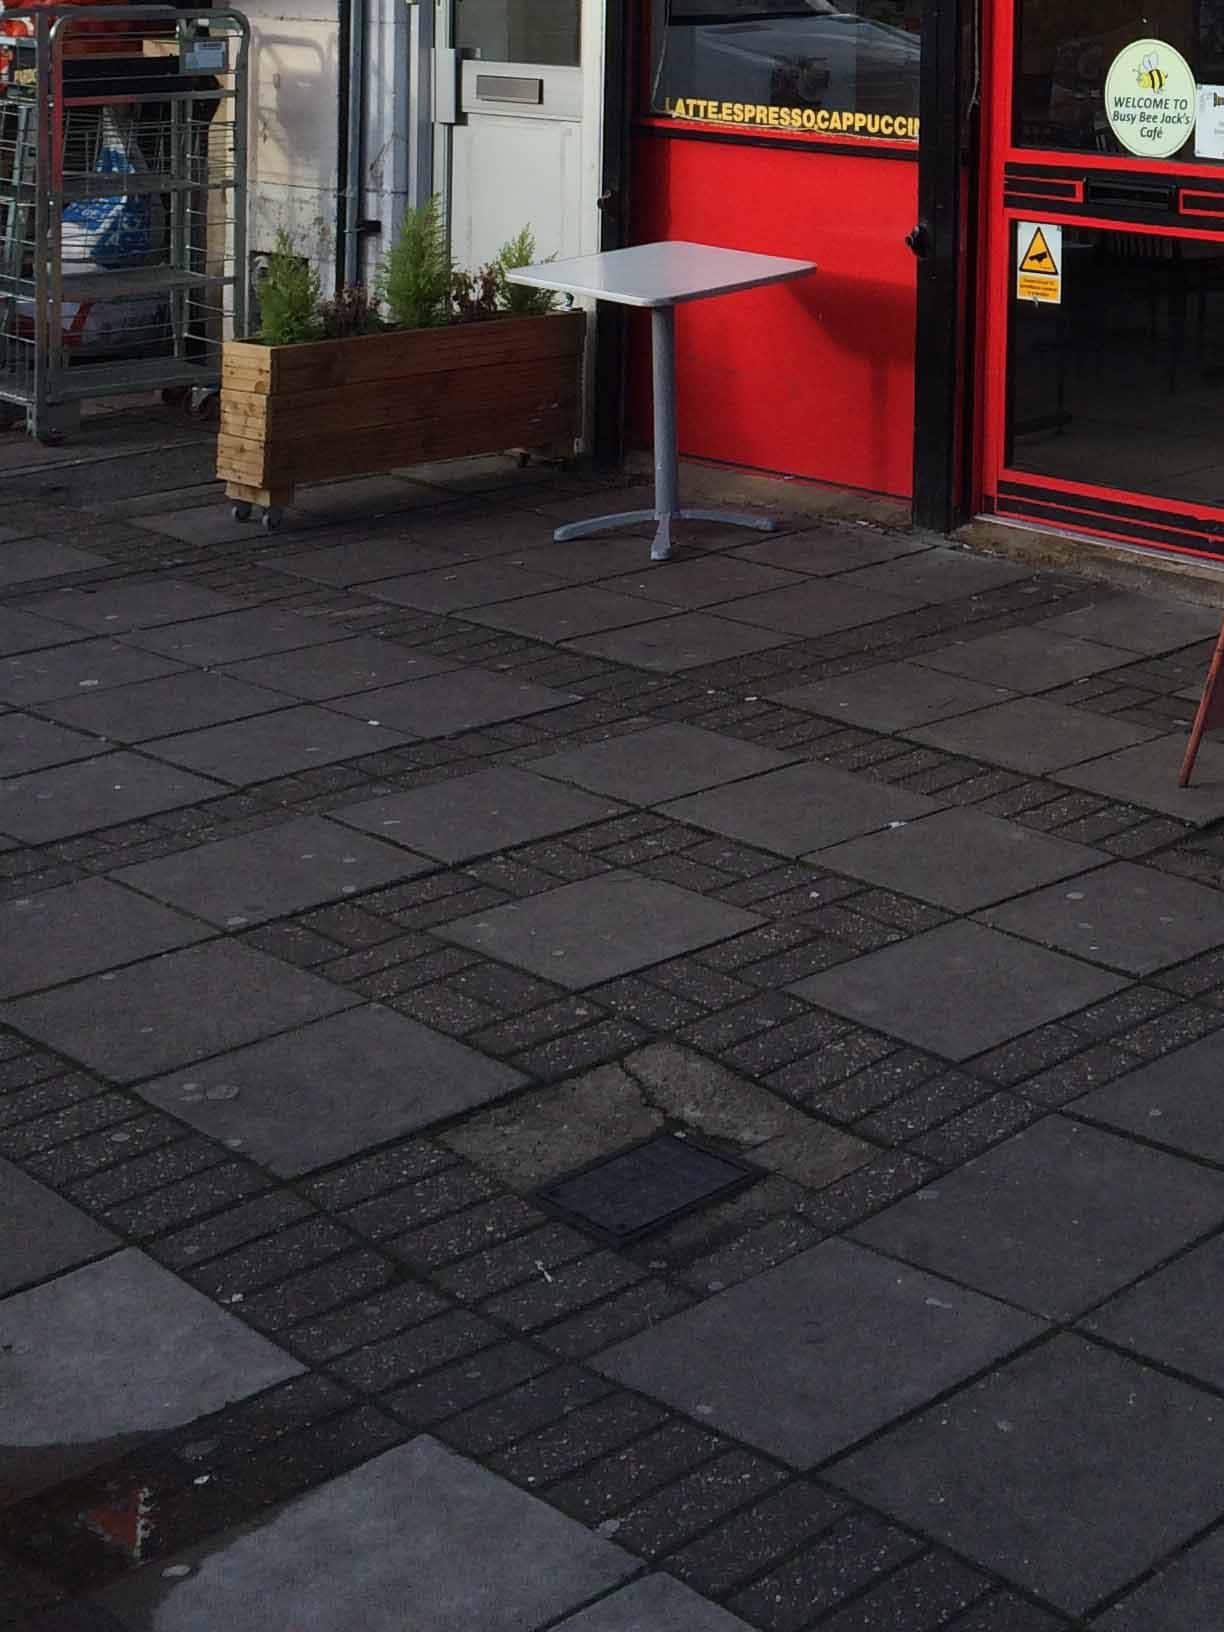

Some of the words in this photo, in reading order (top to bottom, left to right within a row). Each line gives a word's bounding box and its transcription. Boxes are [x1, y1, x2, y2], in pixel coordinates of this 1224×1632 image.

[1114, 96, 1170, 110] WELCOME
[1174, 99, 1188, 110] TO
[1112, 110, 1136, 124] Busy
[1139, 112, 1158, 124] Bee
[1160, 113, 1190, 125] Jack's
[1140, 127, 1163, 140] Café
